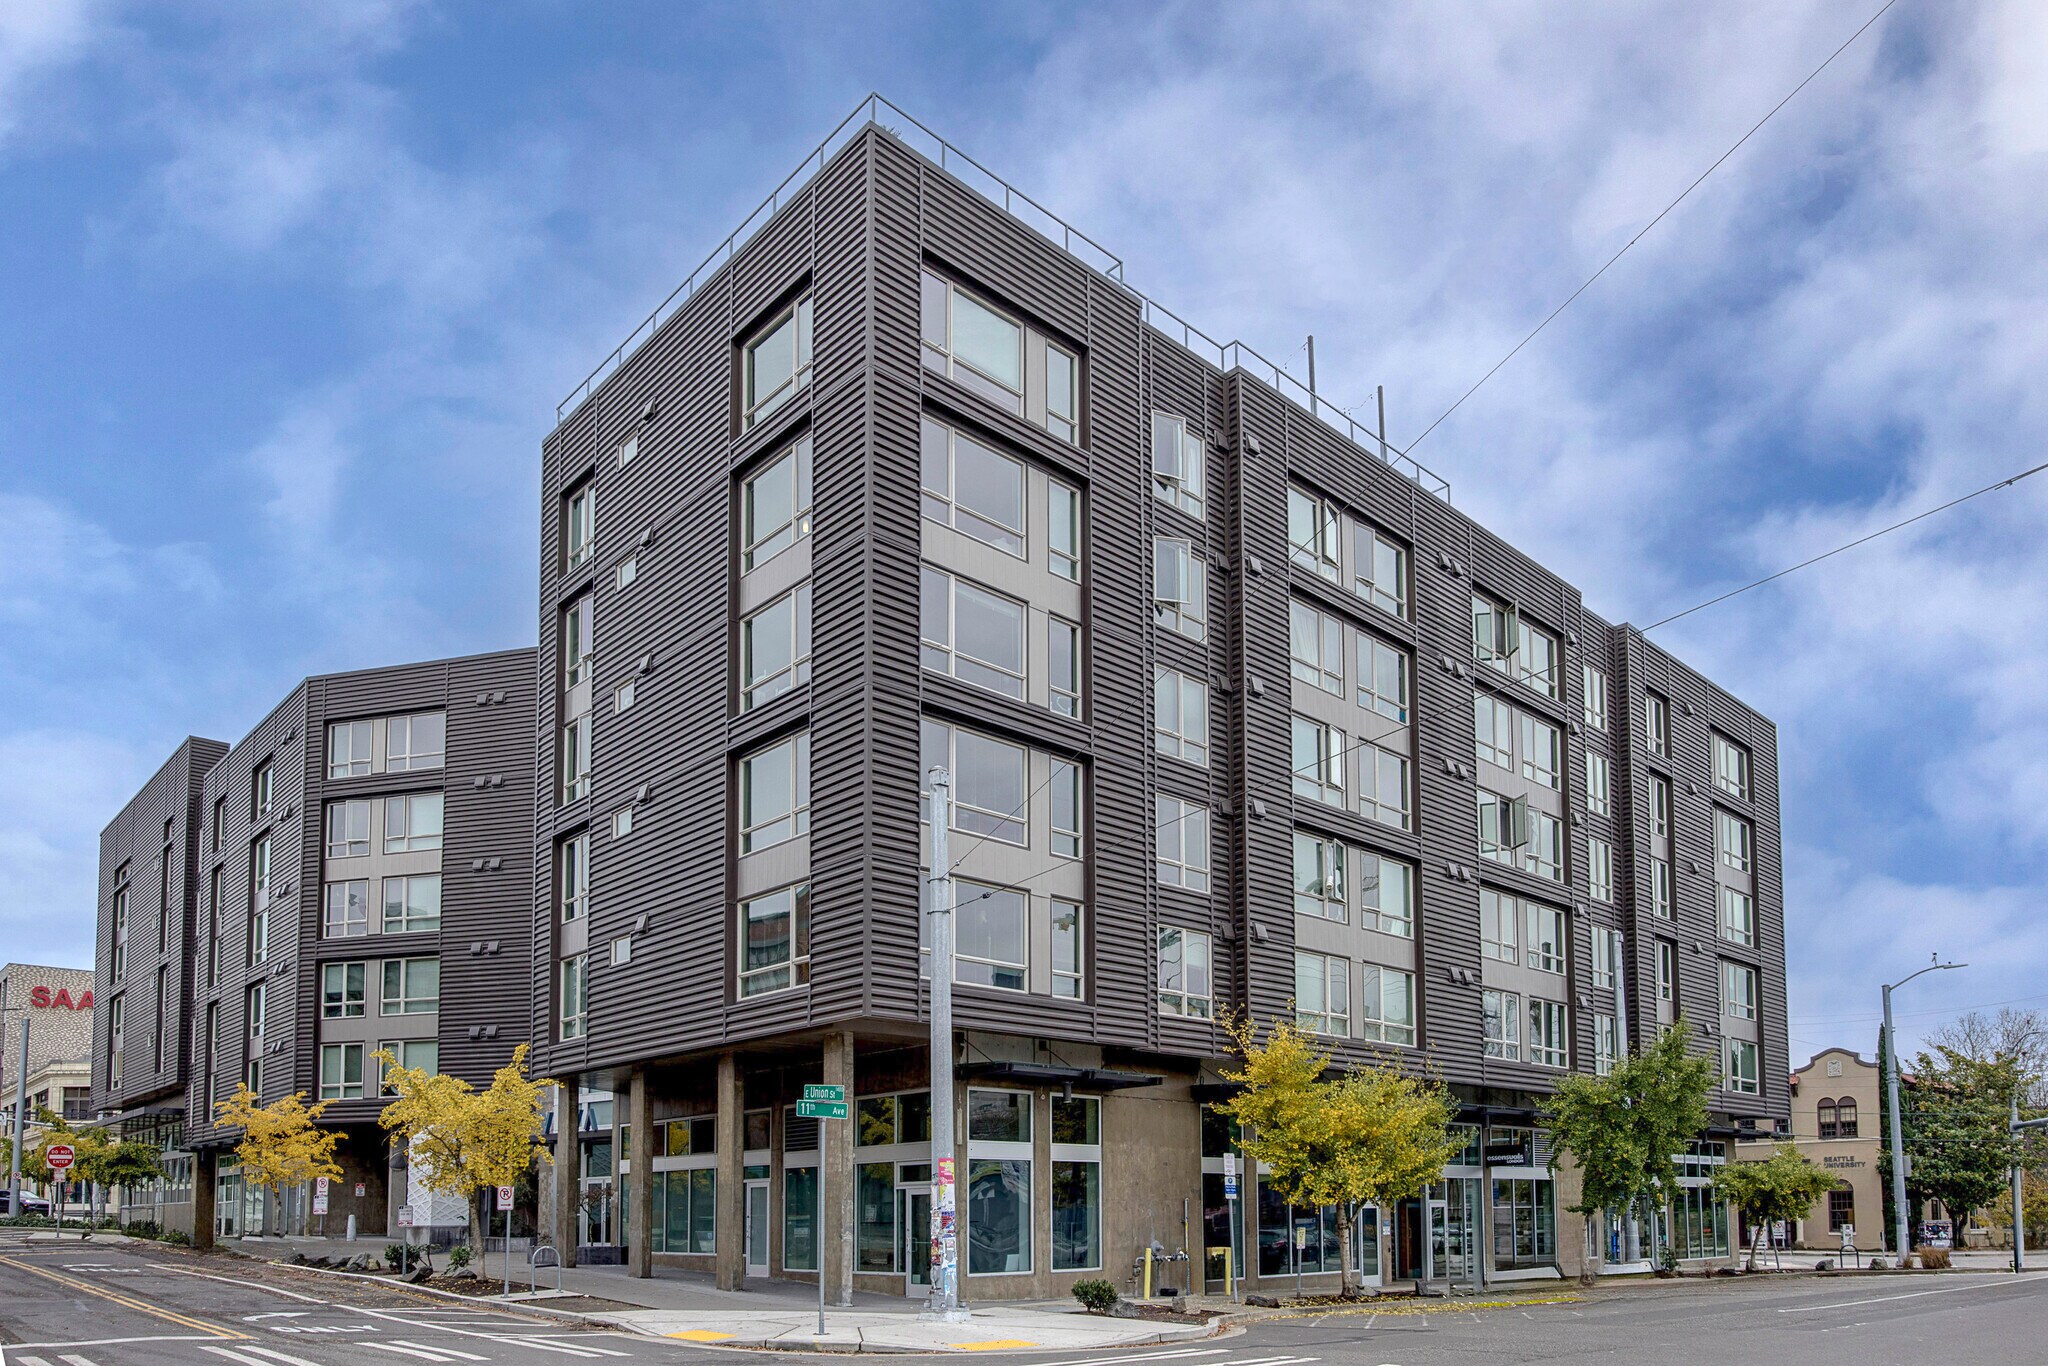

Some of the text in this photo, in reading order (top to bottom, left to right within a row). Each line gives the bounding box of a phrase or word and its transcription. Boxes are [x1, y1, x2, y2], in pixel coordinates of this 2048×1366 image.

[805, 1090, 809, 1098] E
[810, 1086, 829, 1098] Union
[830, 1090, 836, 1099] St
[801, 1103, 845, 1116] 11th Ave
[1486, 1153, 1524, 1162] essensuals
[1823, 1155, 1855, 1163] SEATTLE
[1823, 1161, 1866, 1169] UNIVERSITY
